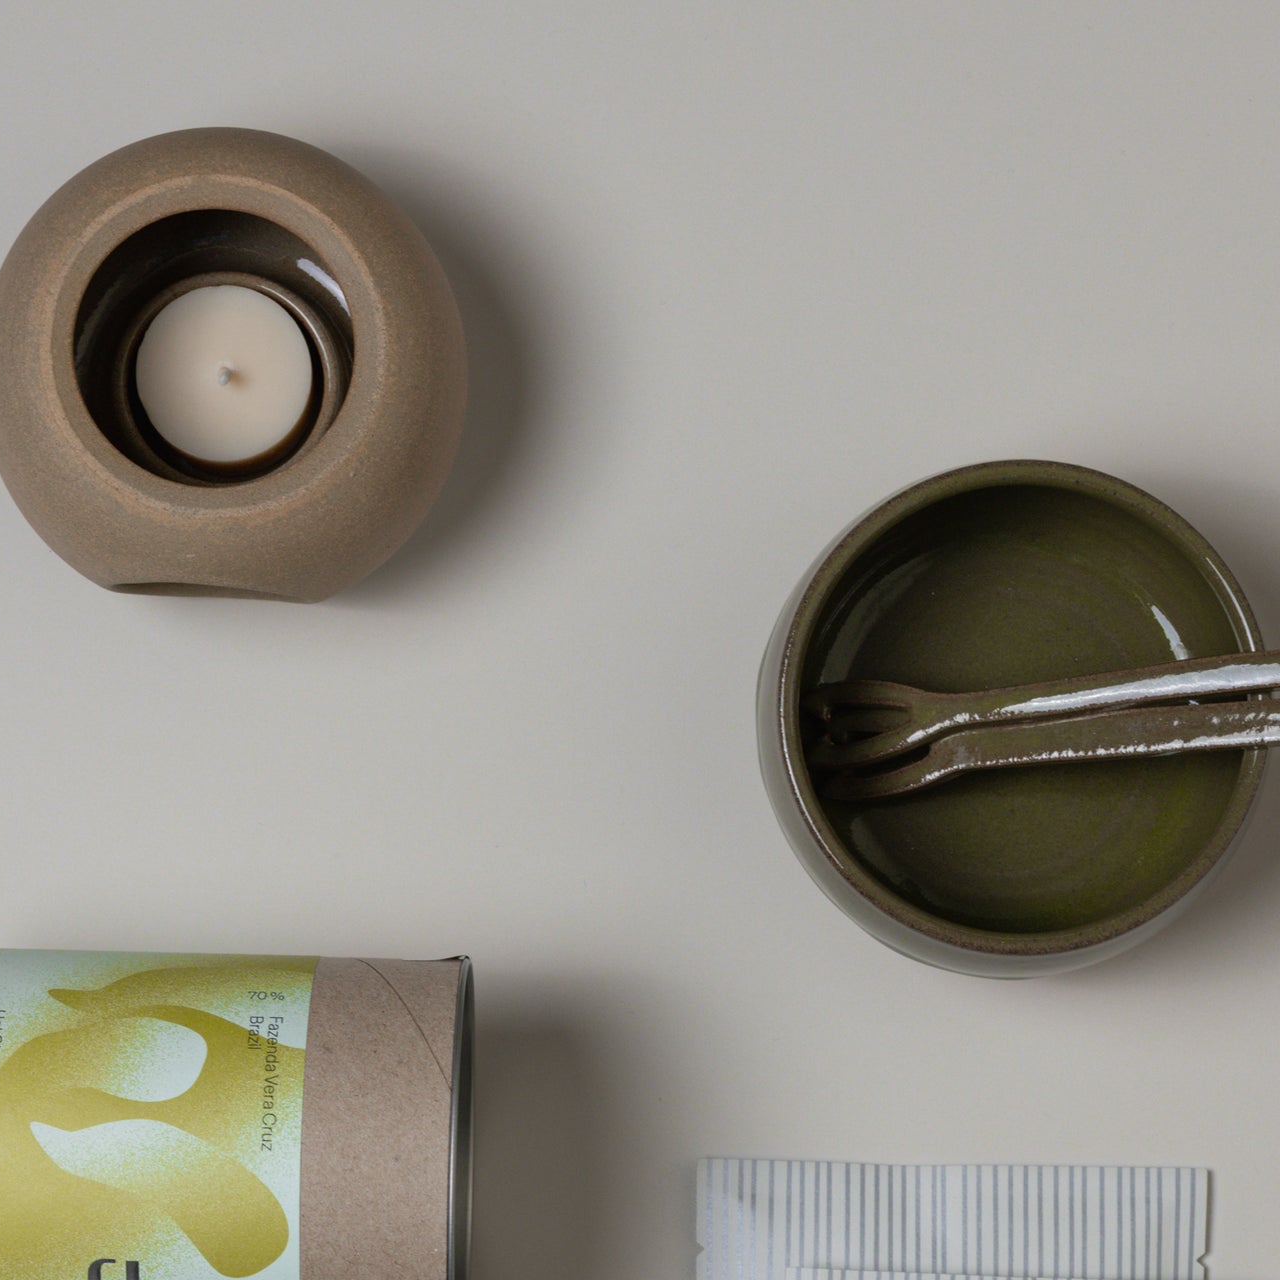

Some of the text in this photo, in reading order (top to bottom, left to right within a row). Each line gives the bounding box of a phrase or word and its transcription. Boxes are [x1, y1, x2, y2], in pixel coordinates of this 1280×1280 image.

[248, 1015, 264, 1051] Brazil
[260, 1016, 285, 1152] Fazenda Vera Cruz
